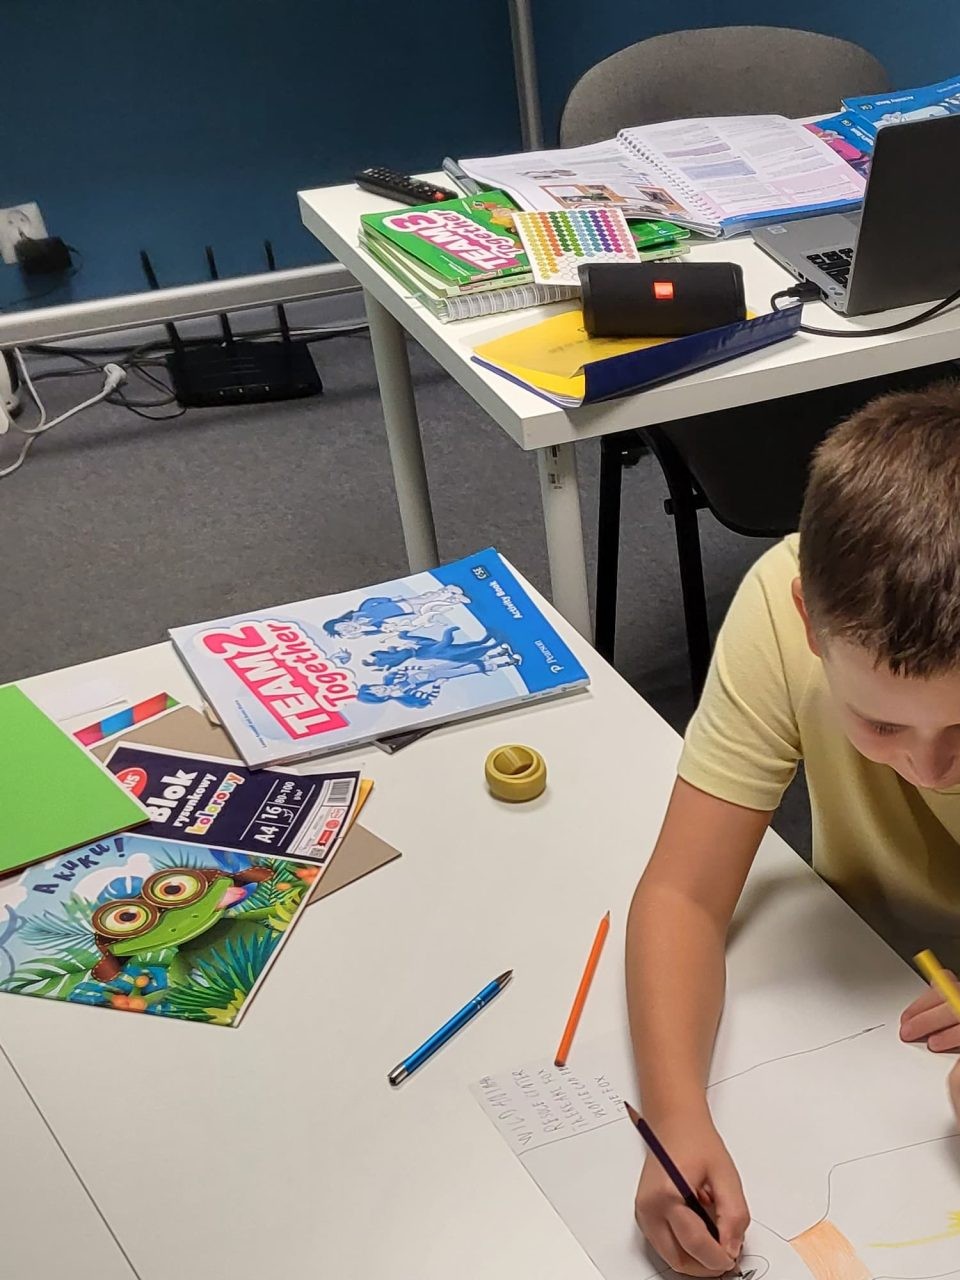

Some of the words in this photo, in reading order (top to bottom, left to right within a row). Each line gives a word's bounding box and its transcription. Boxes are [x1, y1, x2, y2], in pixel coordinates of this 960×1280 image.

[391, 215, 437, 228] 3
[434, 212, 517, 256] Together
[419, 227, 508, 270] TEAM
[490, 581, 506, 597] Book
[502, 596, 523, 619] Activity
[204, 625, 265, 654] 2
[271, 623, 357, 709] Together
[235, 650, 336, 737] TEAM
[146, 768, 198, 822] Blok
[172, 773, 217, 826] rysunkowy
[184, 771, 244, 834] kolorowy
[273, 780, 294, 804] 80-100
[260, 804, 281, 818] 16
[253, 825, 279, 842] A4
[595, 1075, 612, 1093] FOX
[498, 1108, 532, 1145] WILD
